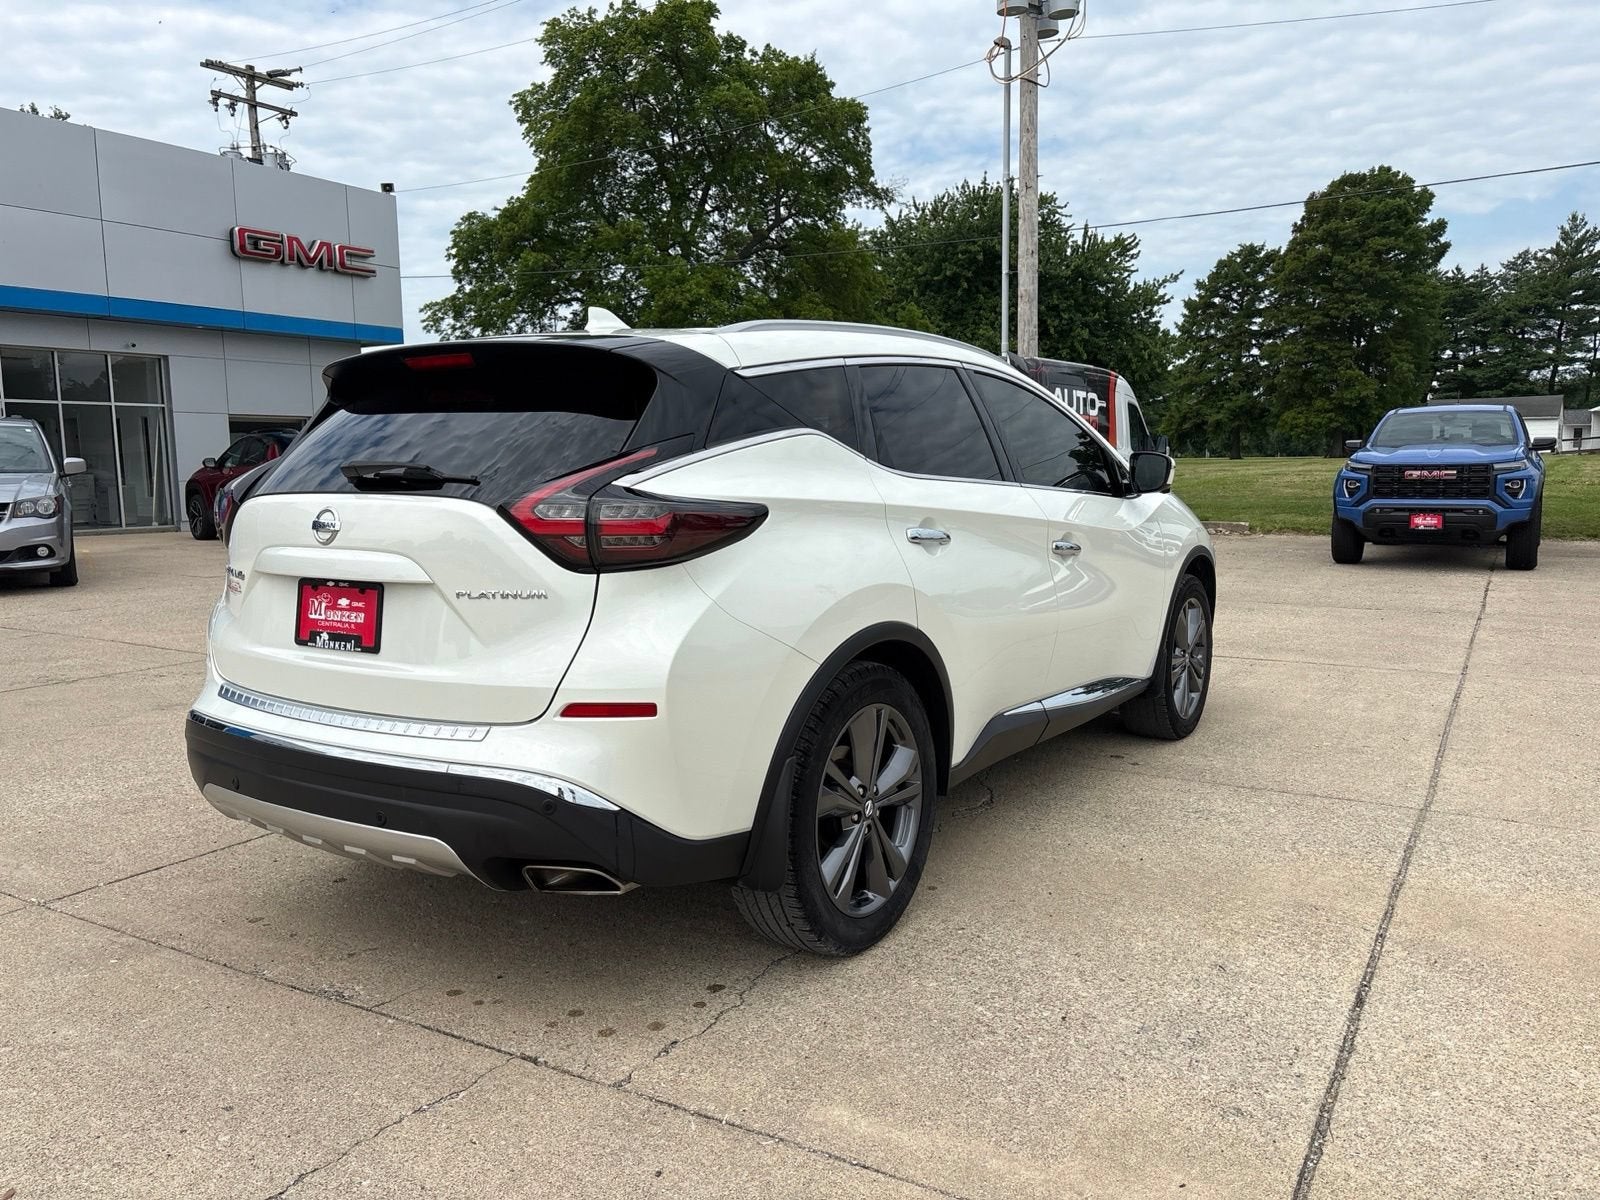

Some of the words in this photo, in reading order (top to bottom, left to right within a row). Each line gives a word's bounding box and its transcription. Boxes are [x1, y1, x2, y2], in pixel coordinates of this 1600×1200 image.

[229, 225, 377, 278] GMC
[1404, 470, 1457, 480] GMC
[455, 590, 549, 600] PLATINUM
[308, 598, 365, 623] MONKEN
